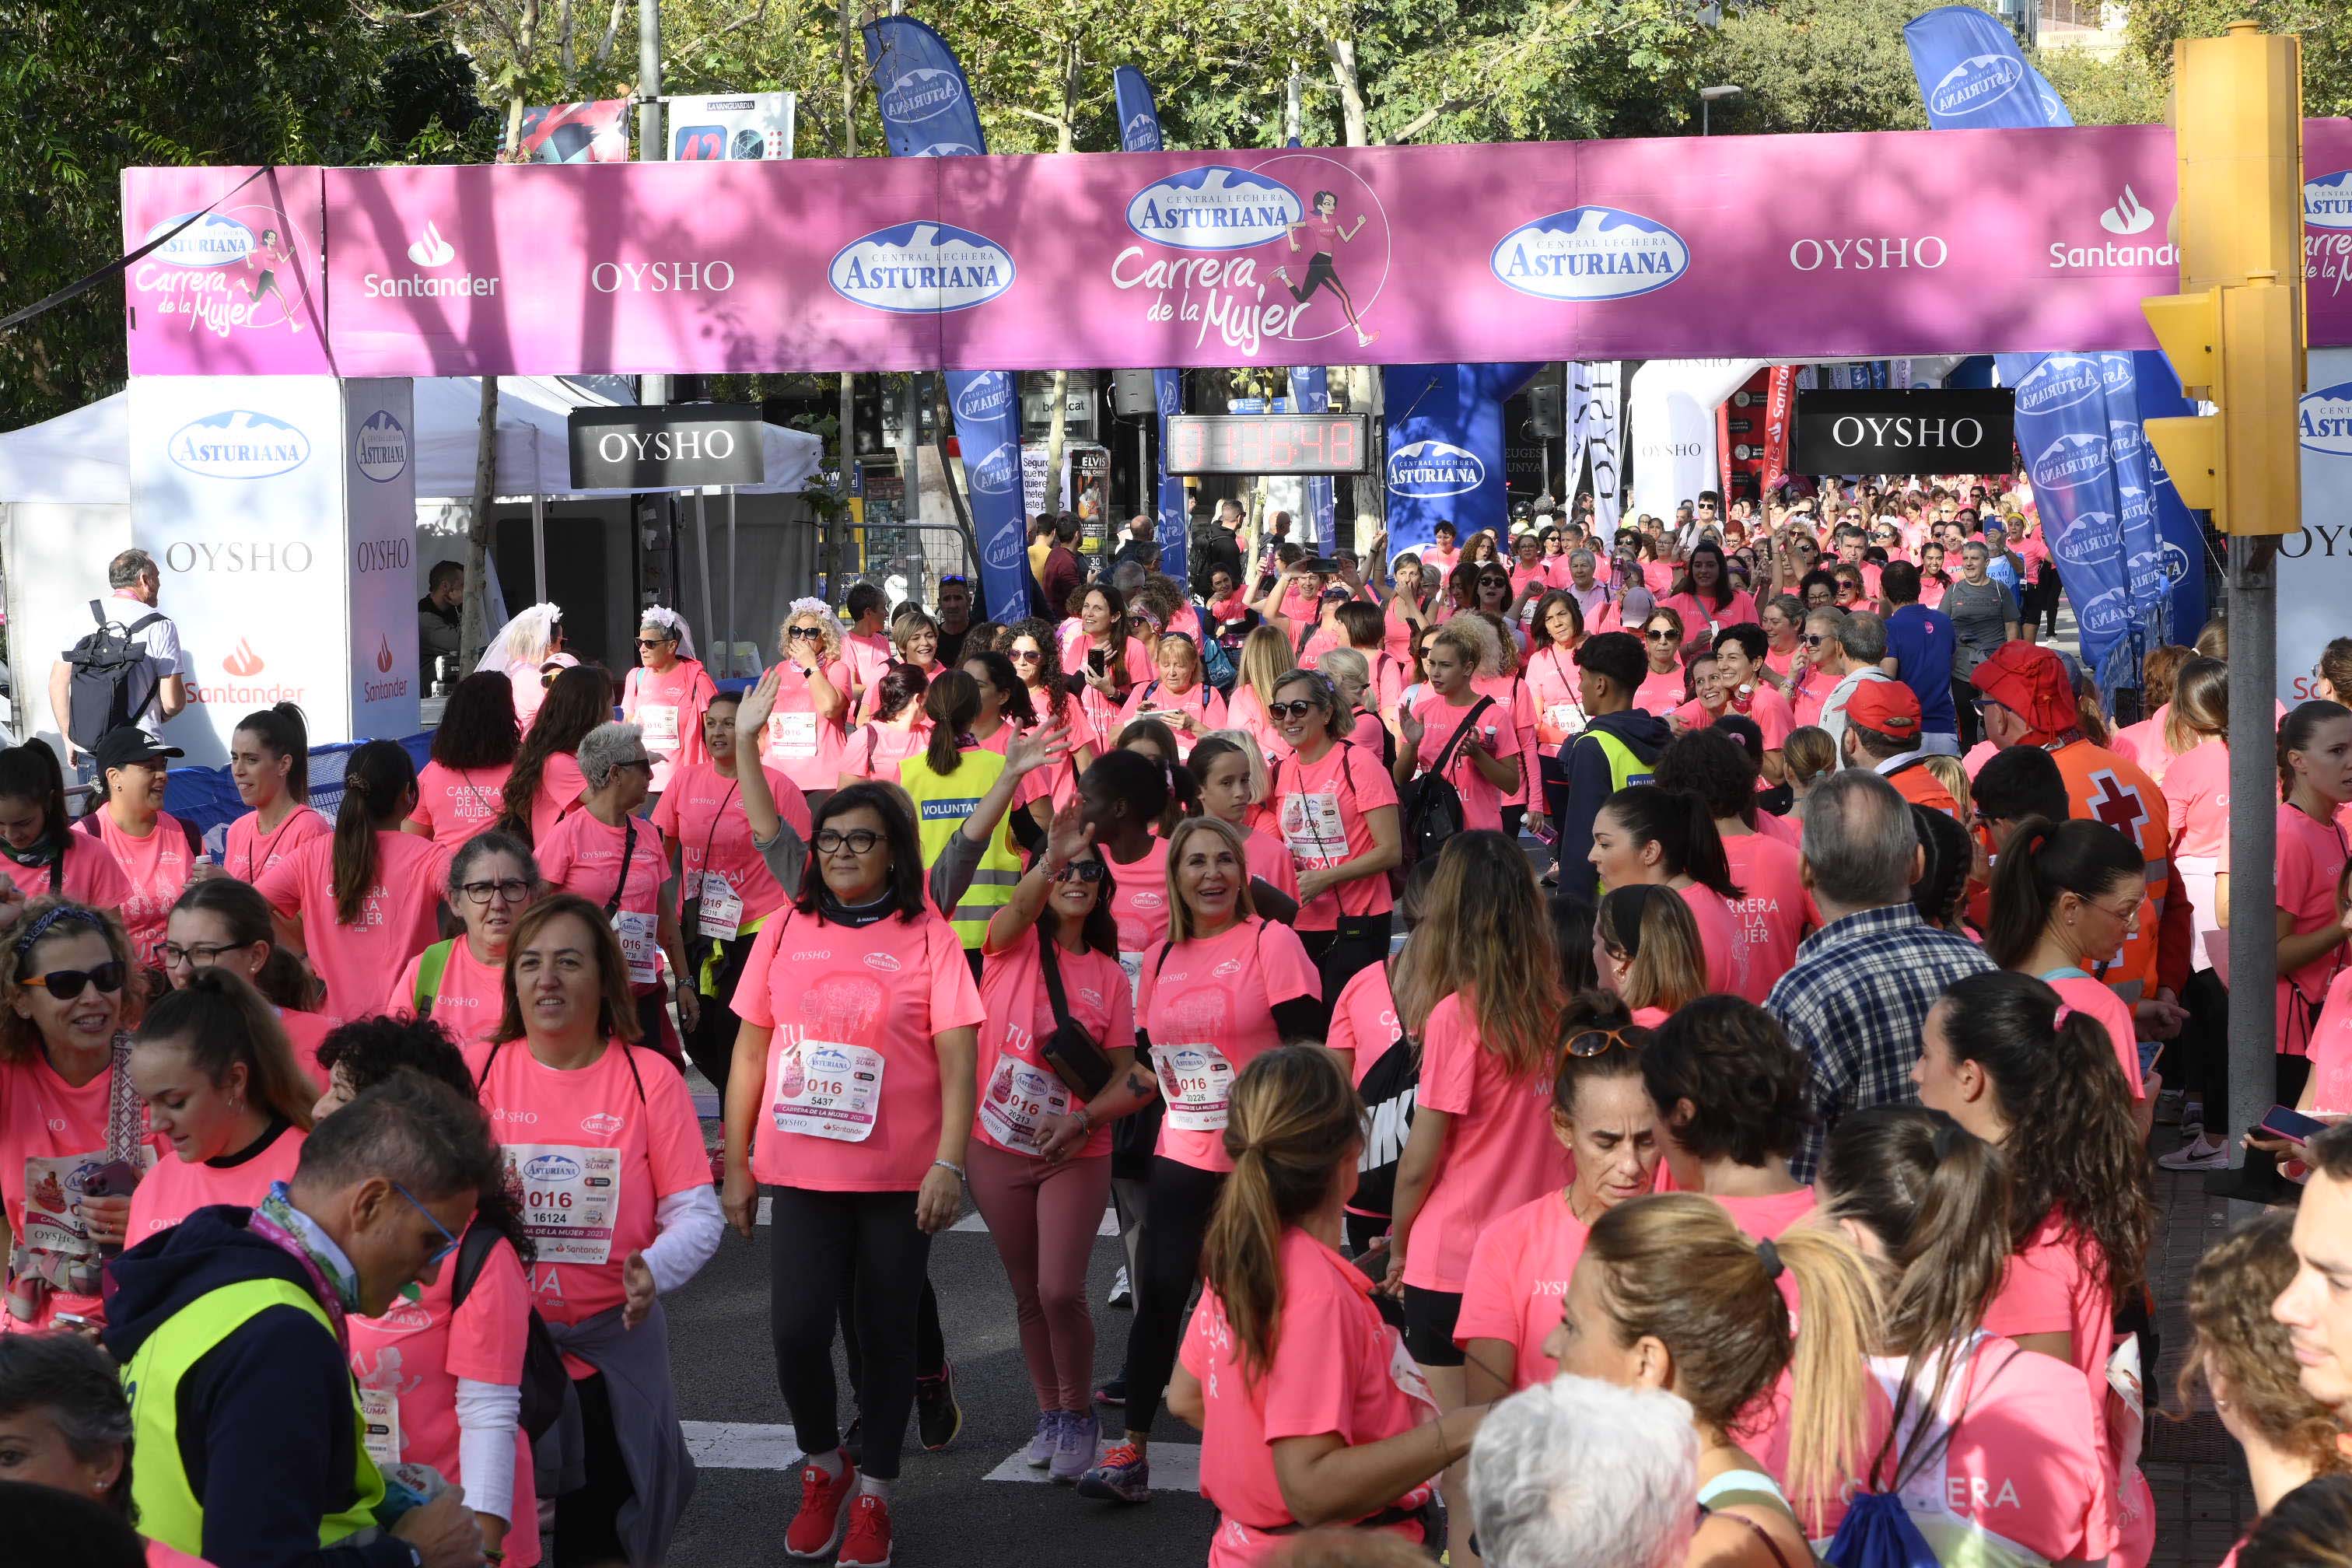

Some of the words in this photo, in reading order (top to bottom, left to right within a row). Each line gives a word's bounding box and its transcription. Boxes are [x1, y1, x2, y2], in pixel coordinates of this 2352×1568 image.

[715, 102, 754, 110] VANGUARDIA
[1167, 195, 1223, 204] CENTRAL
[1229, 194, 1284, 202] LECHERA
[1139, 198, 1288, 229] ASTURIANA
[1537, 240, 1596, 249] CENTRAL
[1605, 237, 1668, 247] LECHERA
[872, 253, 929, 262] CENTRAL
[937, 252, 995, 261] LECHERA
[1506, 243, 1674, 277] ASTURIANA
[1790, 236, 1948, 271] OYSHO
[843, 255, 1001, 289] ASTURIANA
[1111, 246, 1257, 289] Carrera
[2322, 257, 2336, 278] la
[135, 264, 226, 293] Carrera
[591, 261, 734, 293] OYSHO
[364, 272, 499, 297] Santander
[158, 294, 174, 314] de
[179, 292, 191, 314] la
[190, 289, 261, 338] Mujer
[1146, 291, 1174, 323] de
[1180, 289, 1199, 322] la
[1195, 284, 1311, 357] Mujer
[1833, 416, 1983, 448] OYSHO
[180, 436, 299, 462] ASTURIANA
[359, 440, 405, 466] ASTURIANA
[599, 429, 734, 463] OYSHO
[1506, 448, 1542, 457] EUGES
[1082, 457, 1106, 467] ELVIS
[1507, 462, 1542, 473] UNYA
[1024, 470, 1036, 478] que
[1390, 464, 1478, 485] ASTURIANA
[1024, 479, 1048, 488] quiere
[166, 541, 312, 572] OYSHO
[358, 537, 409, 573] OYSHO
[1090, 557, 1101, 565] 30
[185, 682, 307, 705] Santander
[365, 678, 408, 704] Santander
[446, 786, 502, 798] CARRERA
[457, 797, 471, 807] DE
[475, 797, 489, 807] LA
[690, 797, 716, 806] OYSHO
[454, 807, 492, 817] MUJER
[582, 850, 613, 860] OYSHO
[685, 846, 700, 863] TU
[702, 898, 723, 908] 016
[1725, 898, 1780, 913] RRERA
[1745, 914, 1766, 928] LA
[622, 939, 641, 950] 016
[792, 950, 831, 961] OYSHO
[866, 956, 898, 970] ASTURIANA
[437, 995, 479, 1008] OYSHO
[779, 1024, 804, 1045] TU
[1006, 1023, 1033, 1051] TU
[811, 1058, 848, 1069] ASTURIANA
[856, 1057, 876, 1068] SUMA
[807, 1079, 843, 1094] 016
[1017, 1074, 1047, 1094] ASTURIANA
[1181, 1078, 1206, 1091] 016
[811, 1097, 834, 1106] 5437
[1011, 1094, 1040, 1115] 016
[493, 1108, 537, 1125] OYSHO
[777, 1118, 807, 1128] OYSHO
[1009, 1109, 1031, 1125] 20213
[585, 1117, 621, 1132] ASTURIANA
[831, 1124, 865, 1136] Santander
[528, 1164, 576, 1176] ASTURIANA
[529, 1191, 572, 1208] 016
[73, 1220, 86, 1230] 16
[534, 1213, 566, 1223] 16124
[566, 1244, 605, 1255] Santander
[361, 1406, 387, 1416] SUMA
